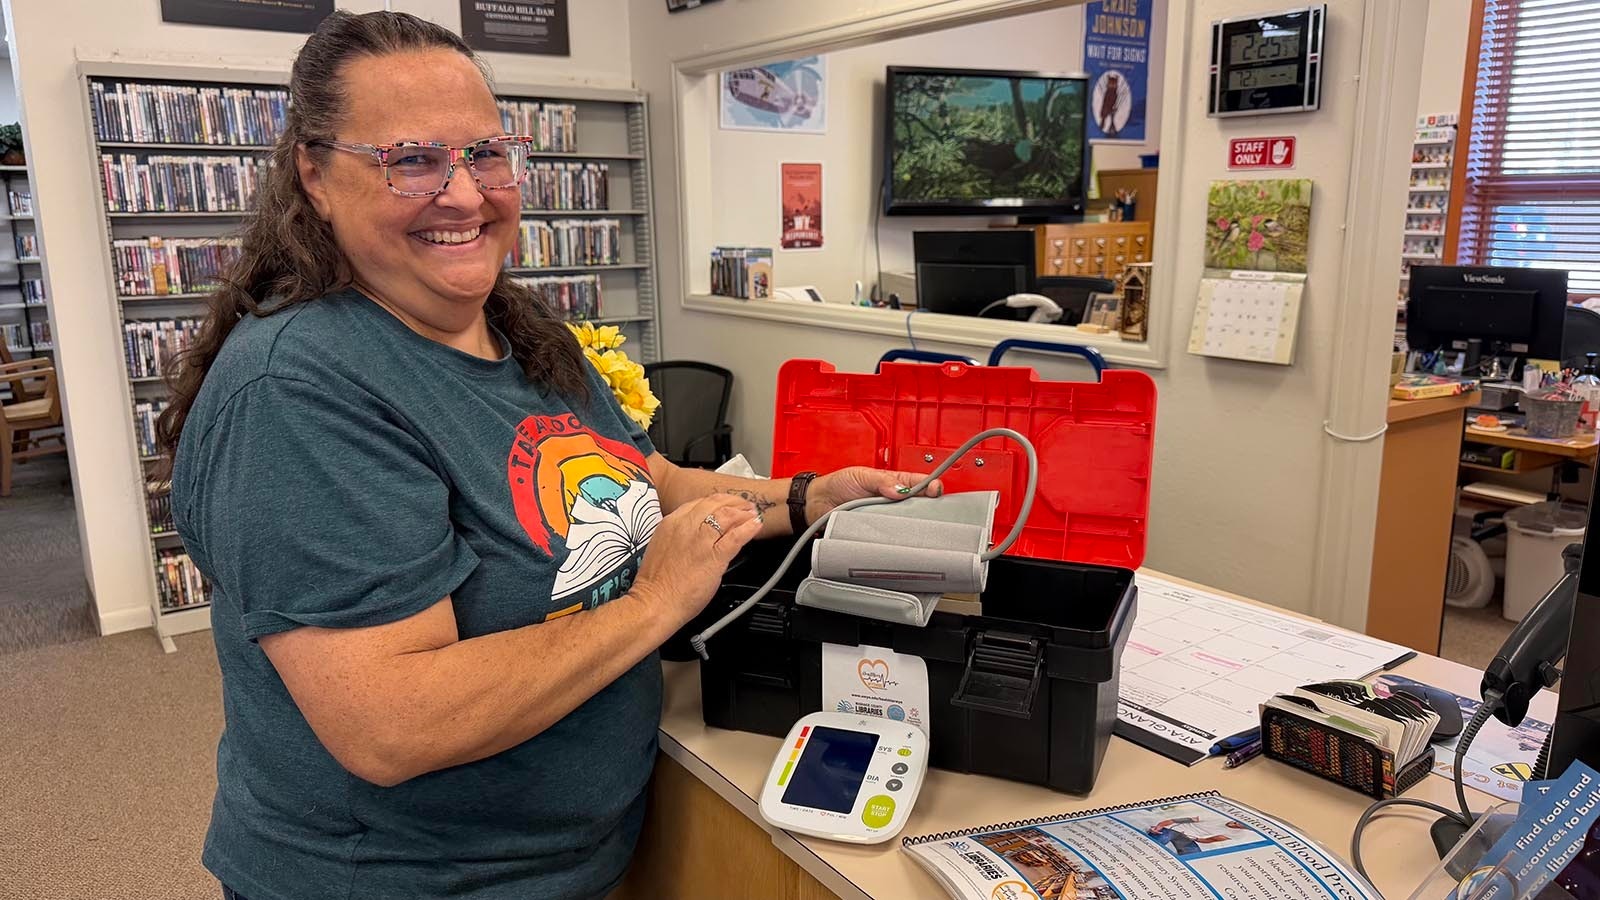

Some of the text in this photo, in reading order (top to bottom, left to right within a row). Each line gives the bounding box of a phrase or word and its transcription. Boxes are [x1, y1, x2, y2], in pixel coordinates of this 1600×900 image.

[475, 2, 555, 17] BUFFALO BILL DAM
[1092, 14, 1146, 38] JOHNSON
[1086, 44, 1146, 63] WAIT FOR SIGNS
[1234, 141, 1265, 154] STAFF
[1234, 153, 1263, 165] ONLY
[1462, 273, 1506, 285] ViewSonic
[855, 705, 883, 716] LIBRARIES
[866, 774, 880, 782] DIA
[870, 804, 890, 813] START
[1516, 773, 1592, 850] Find tools and
[1285, 836, 1330, 871] Blood
[1515, 828, 1569, 882] resources
[1565, 815, 1580, 830] to
[1546, 833, 1587, 873] library
[965, 851, 1003, 880] LIBRARIES
[1100, 859, 1113, 873] call
[1145, 853, 1171, 876] Library
[1168, 875, 1192, 899] System
[1168, 860, 1186, 873] and
[1233, 864, 1256, 883] your
[1244, 856, 1284, 895] importance
[1266, 858, 1292, 880] blood
[1274, 850, 1297, 868] Learn
[1295, 867, 1314, 884] how
[1312, 883, 1322, 894] to
[1117, 862, 1149, 893] symptoms
[1216, 863, 1249, 894] resources
